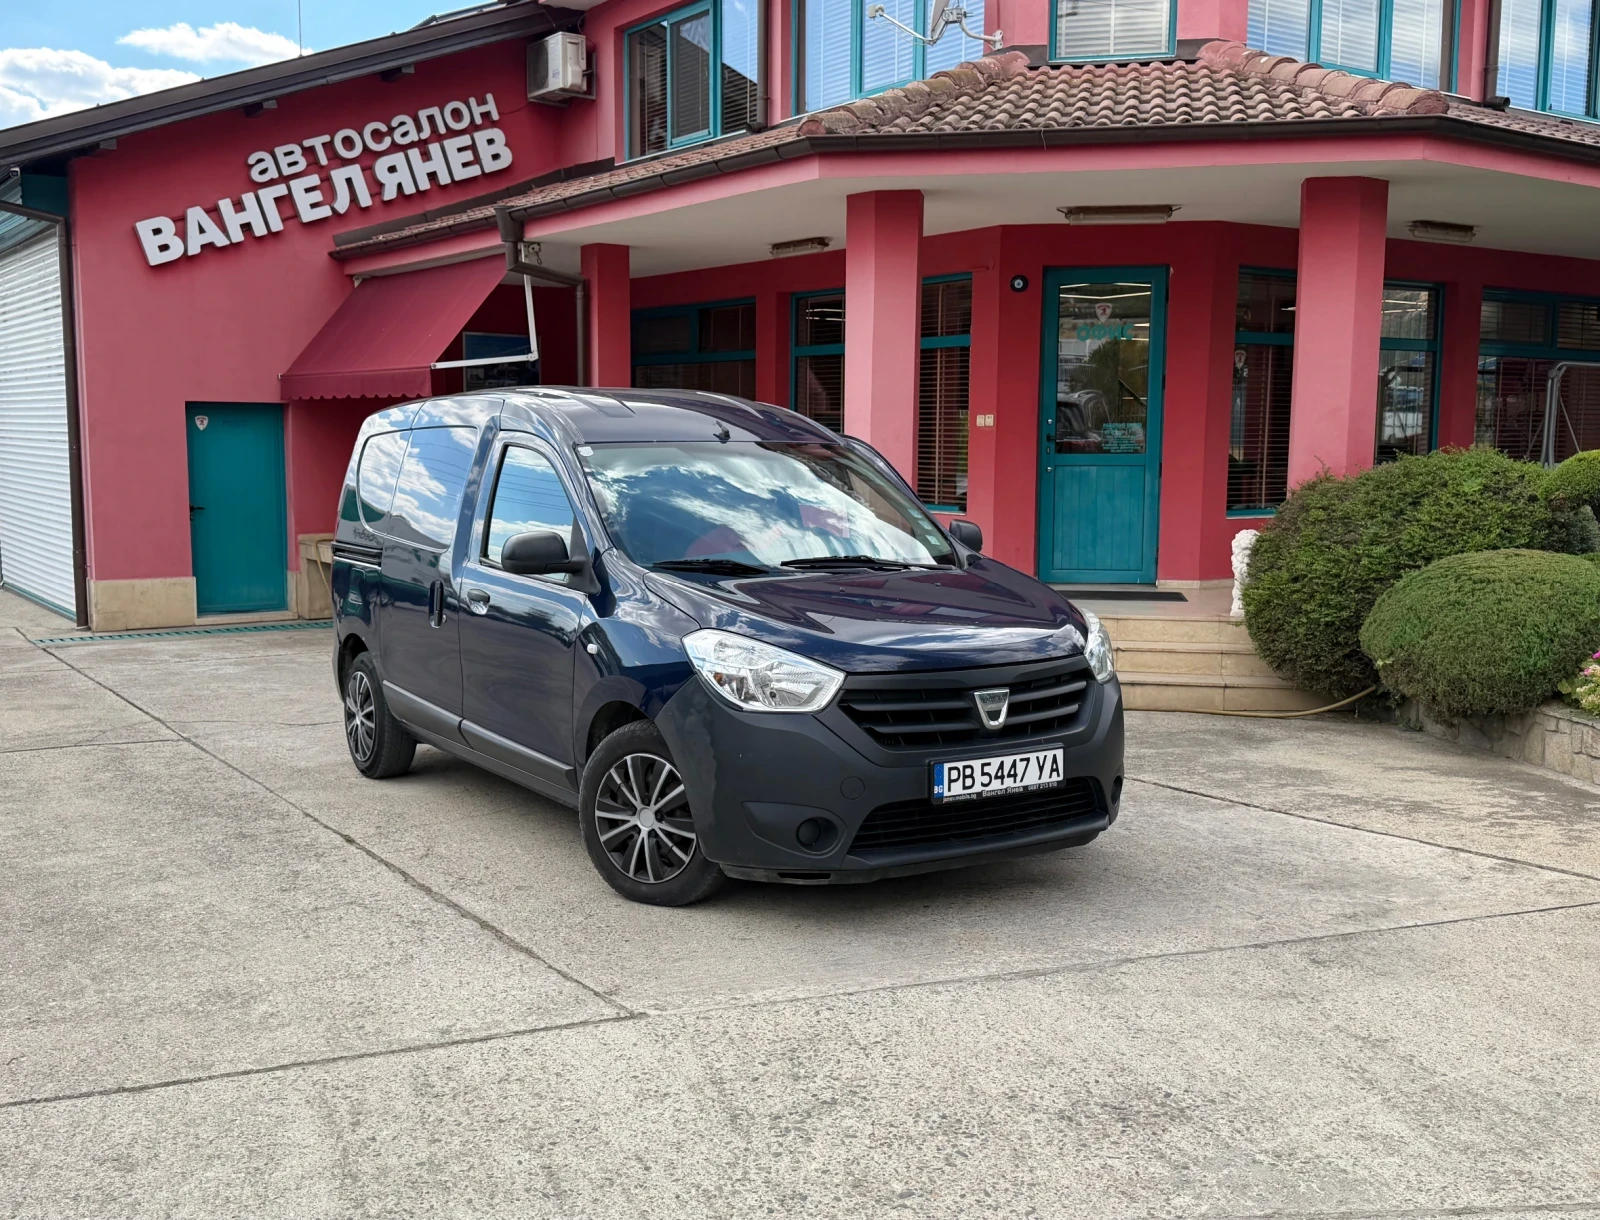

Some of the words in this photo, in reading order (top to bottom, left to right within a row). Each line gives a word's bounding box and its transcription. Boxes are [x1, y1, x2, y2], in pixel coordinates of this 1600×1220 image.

[247, 92, 500, 183] автосалон
[135, 163, 373, 267] ВАНГЕЛ
[373, 127, 513, 202] ЯНЕВ
[1076, 323, 1135, 342] ОФИС
[980, 756, 1031, 788] 5447
[933, 785, 943, 794] BG
